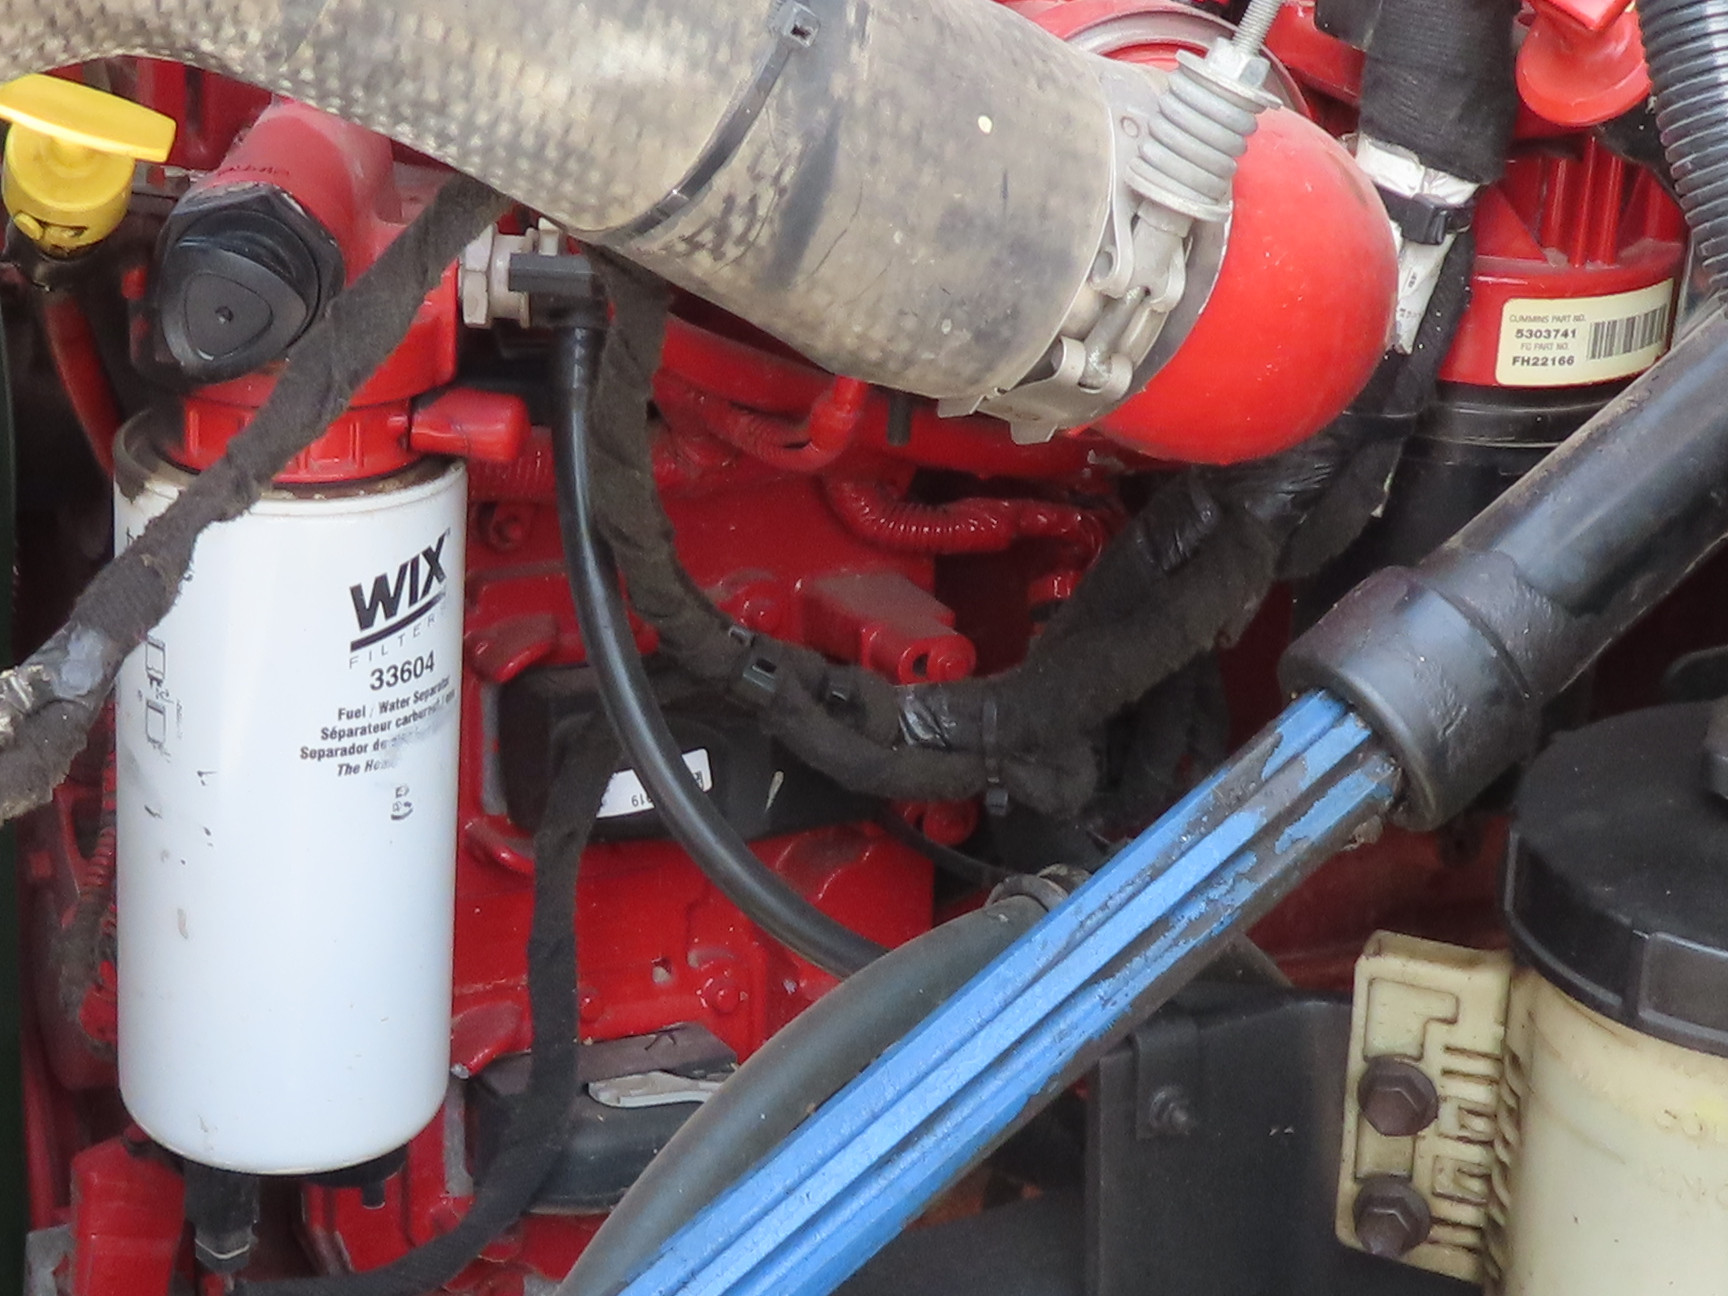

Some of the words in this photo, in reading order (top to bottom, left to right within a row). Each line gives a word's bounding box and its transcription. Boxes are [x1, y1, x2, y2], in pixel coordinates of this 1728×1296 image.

[1509, 314, 1550, 324] CUMMINS
[1551, 314, 1572, 323] PART
[1514, 328, 1577, 340] 5303741
[1533, 342, 1555, 352] PART
[1511, 355, 1575, 367] FH22166
[349, 529, 447, 632] WIX
[370, 650, 435, 691] 33604
[337, 705, 366, 722] Fuel
[377, 696, 411, 715] Water
[320, 720, 391, 742] Séparateur
[299, 743, 369, 762] Separador
[336, 763, 361, 778] The
